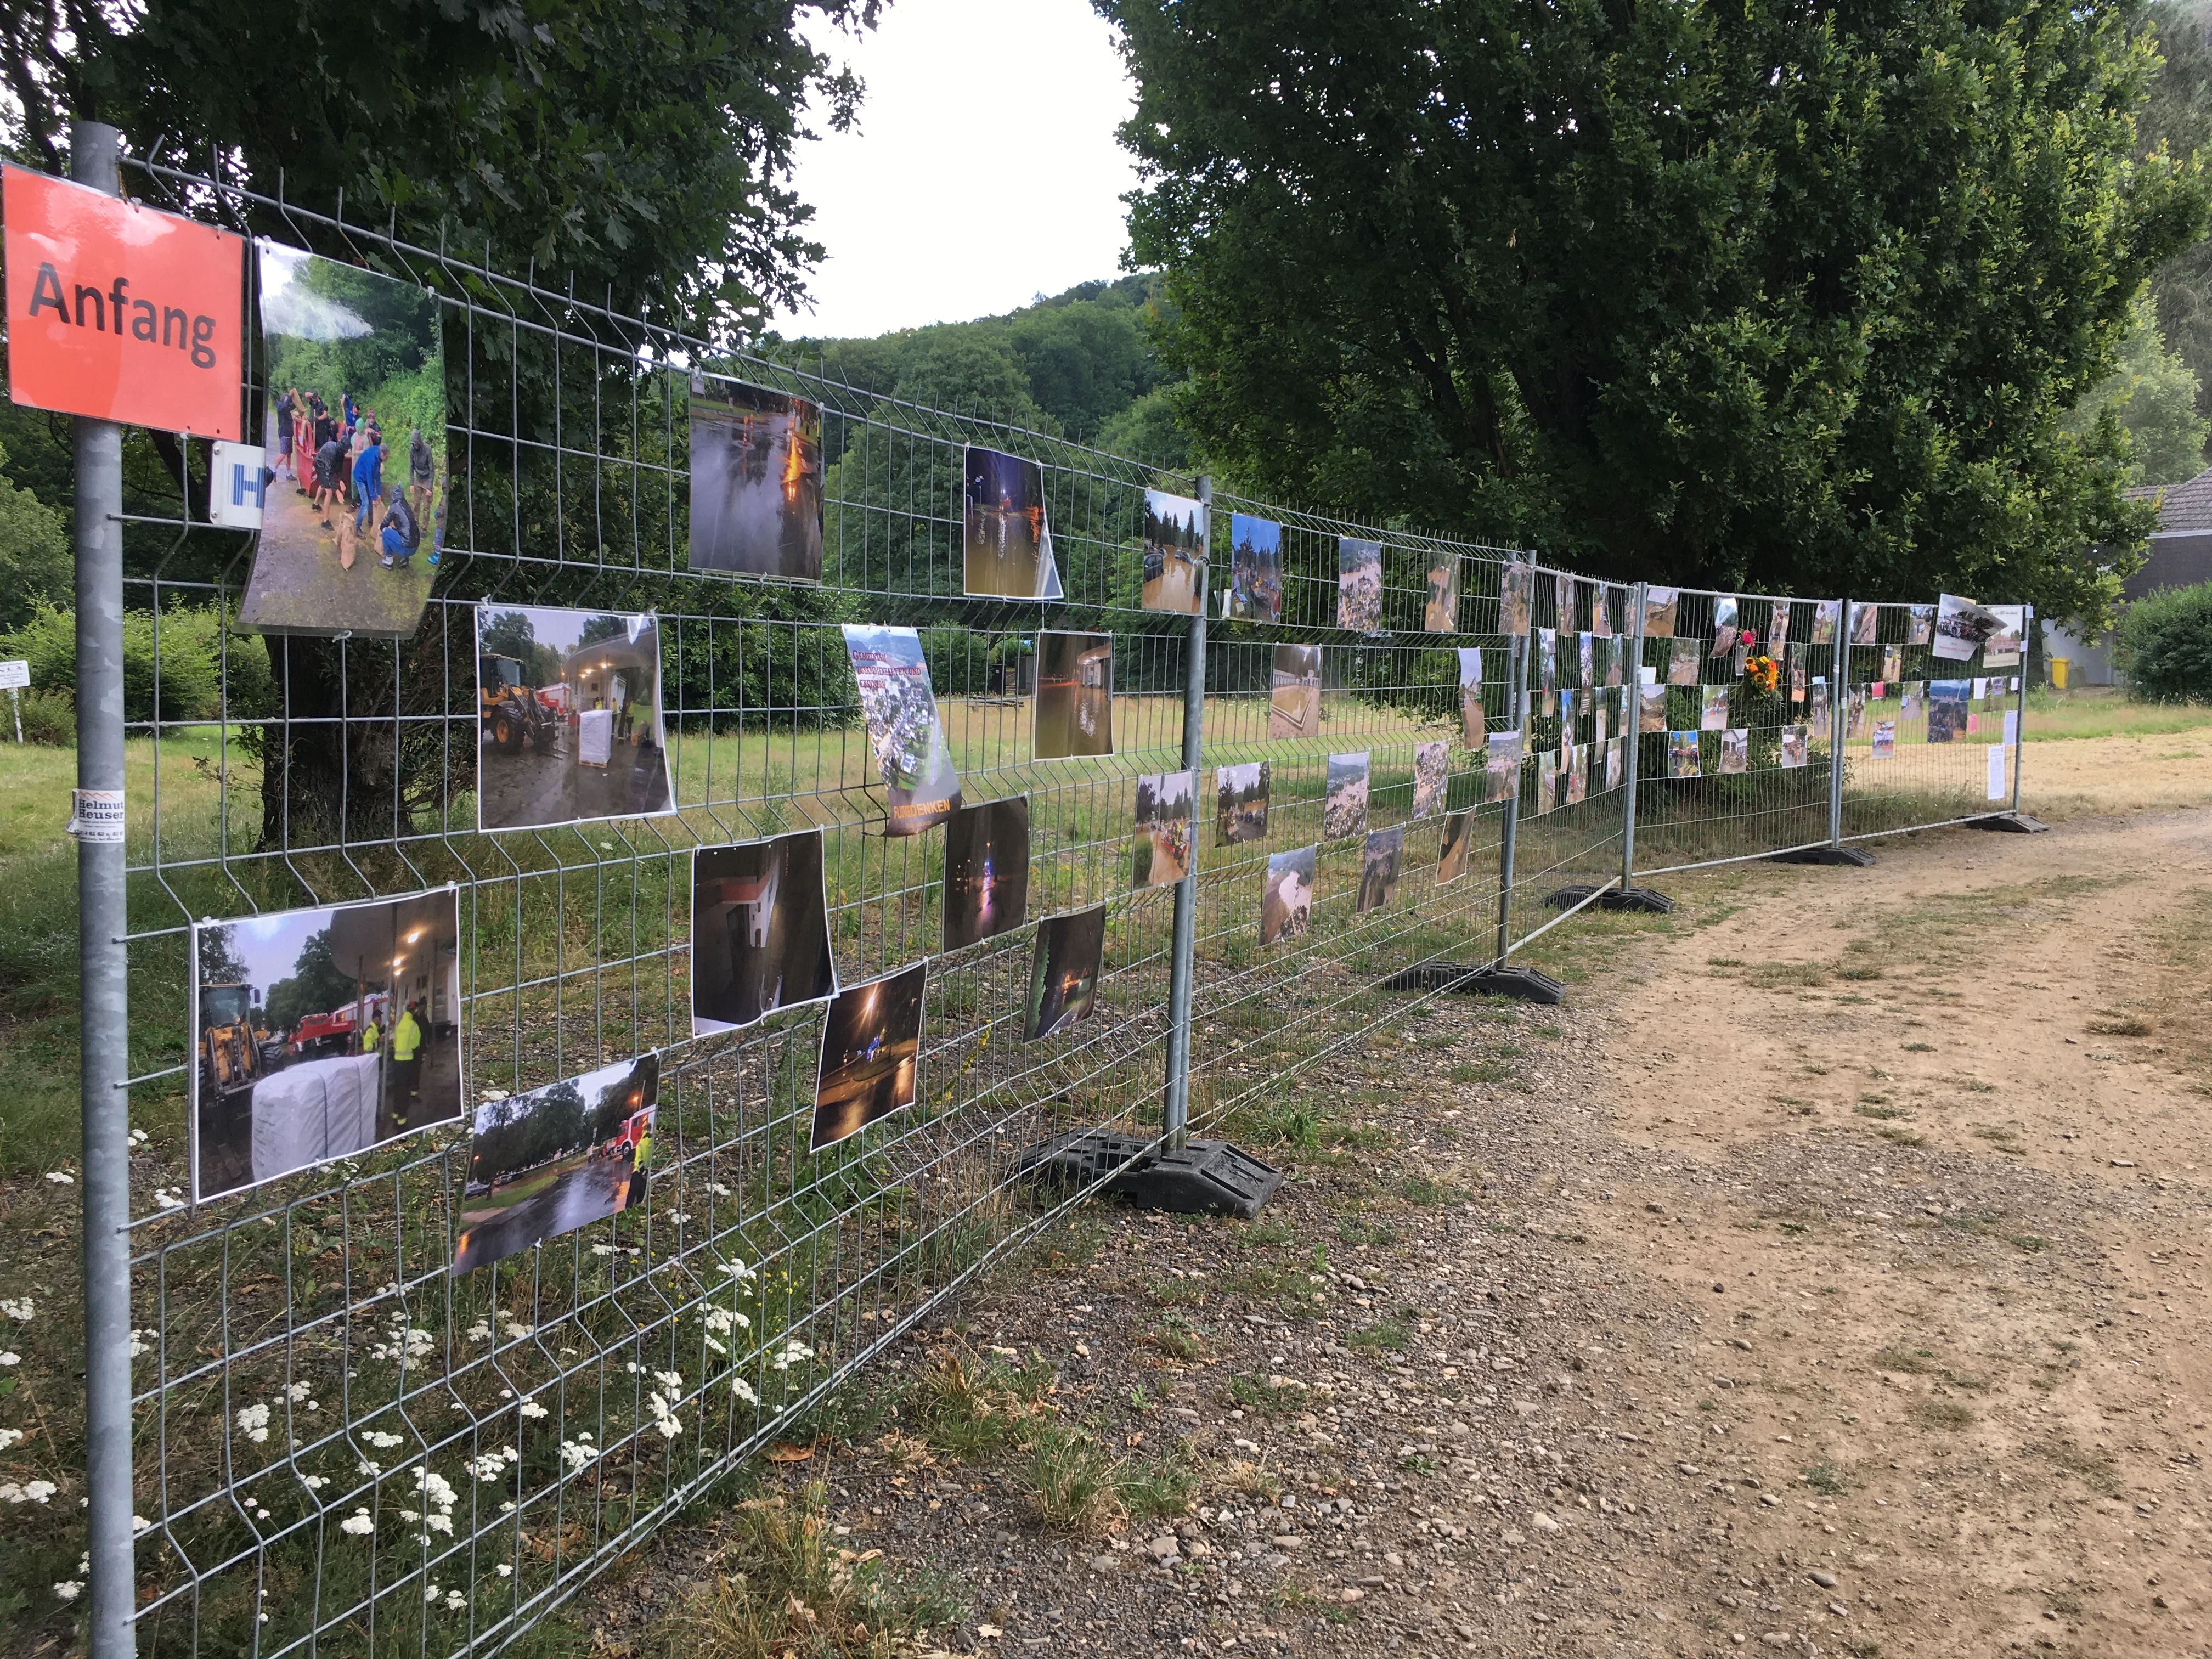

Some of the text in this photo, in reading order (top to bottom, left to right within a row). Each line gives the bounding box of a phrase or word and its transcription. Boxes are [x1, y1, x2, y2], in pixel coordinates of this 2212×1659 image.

[29, 262, 216, 369] Anfang
[908, 667, 922, 676] UND
[78, 799, 123, 809] Helmut
[78, 808, 123, 819] Heuser
